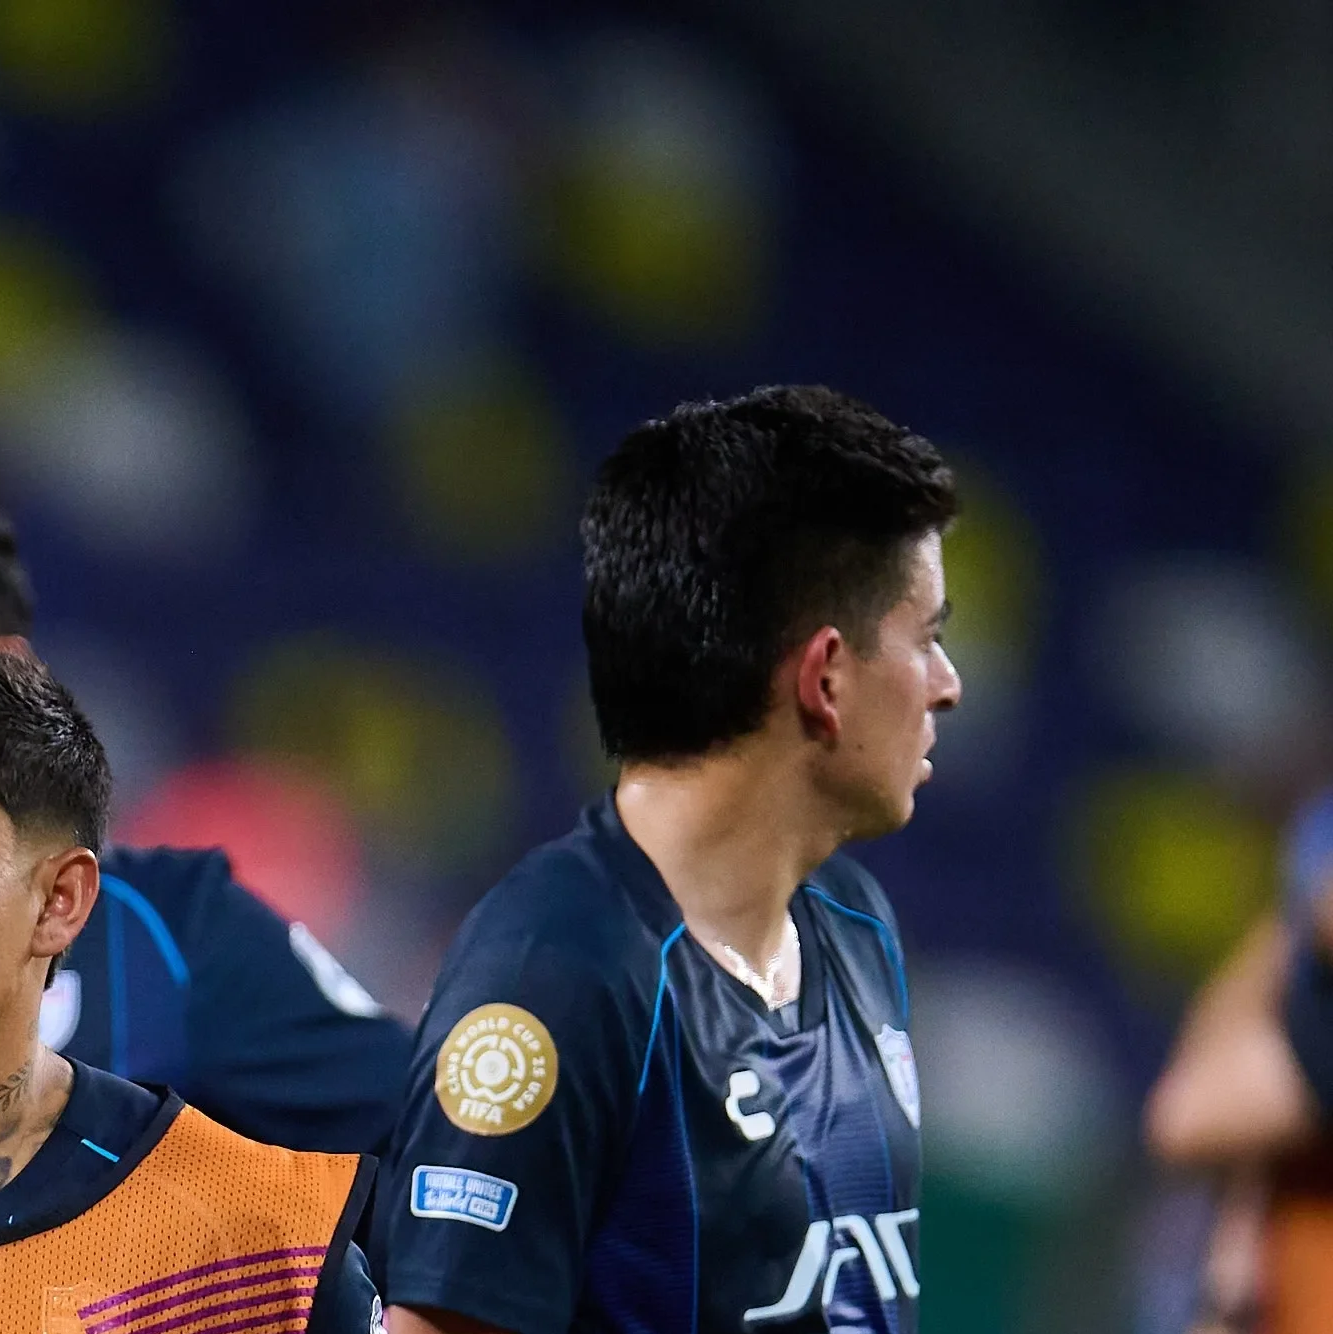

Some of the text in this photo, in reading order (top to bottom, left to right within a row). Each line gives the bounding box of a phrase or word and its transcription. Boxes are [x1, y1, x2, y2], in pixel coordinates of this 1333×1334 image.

[447, 1016, 546, 1112] CLUB WORLD CUP 25 USA
[459, 1098, 503, 1125] FIFA
